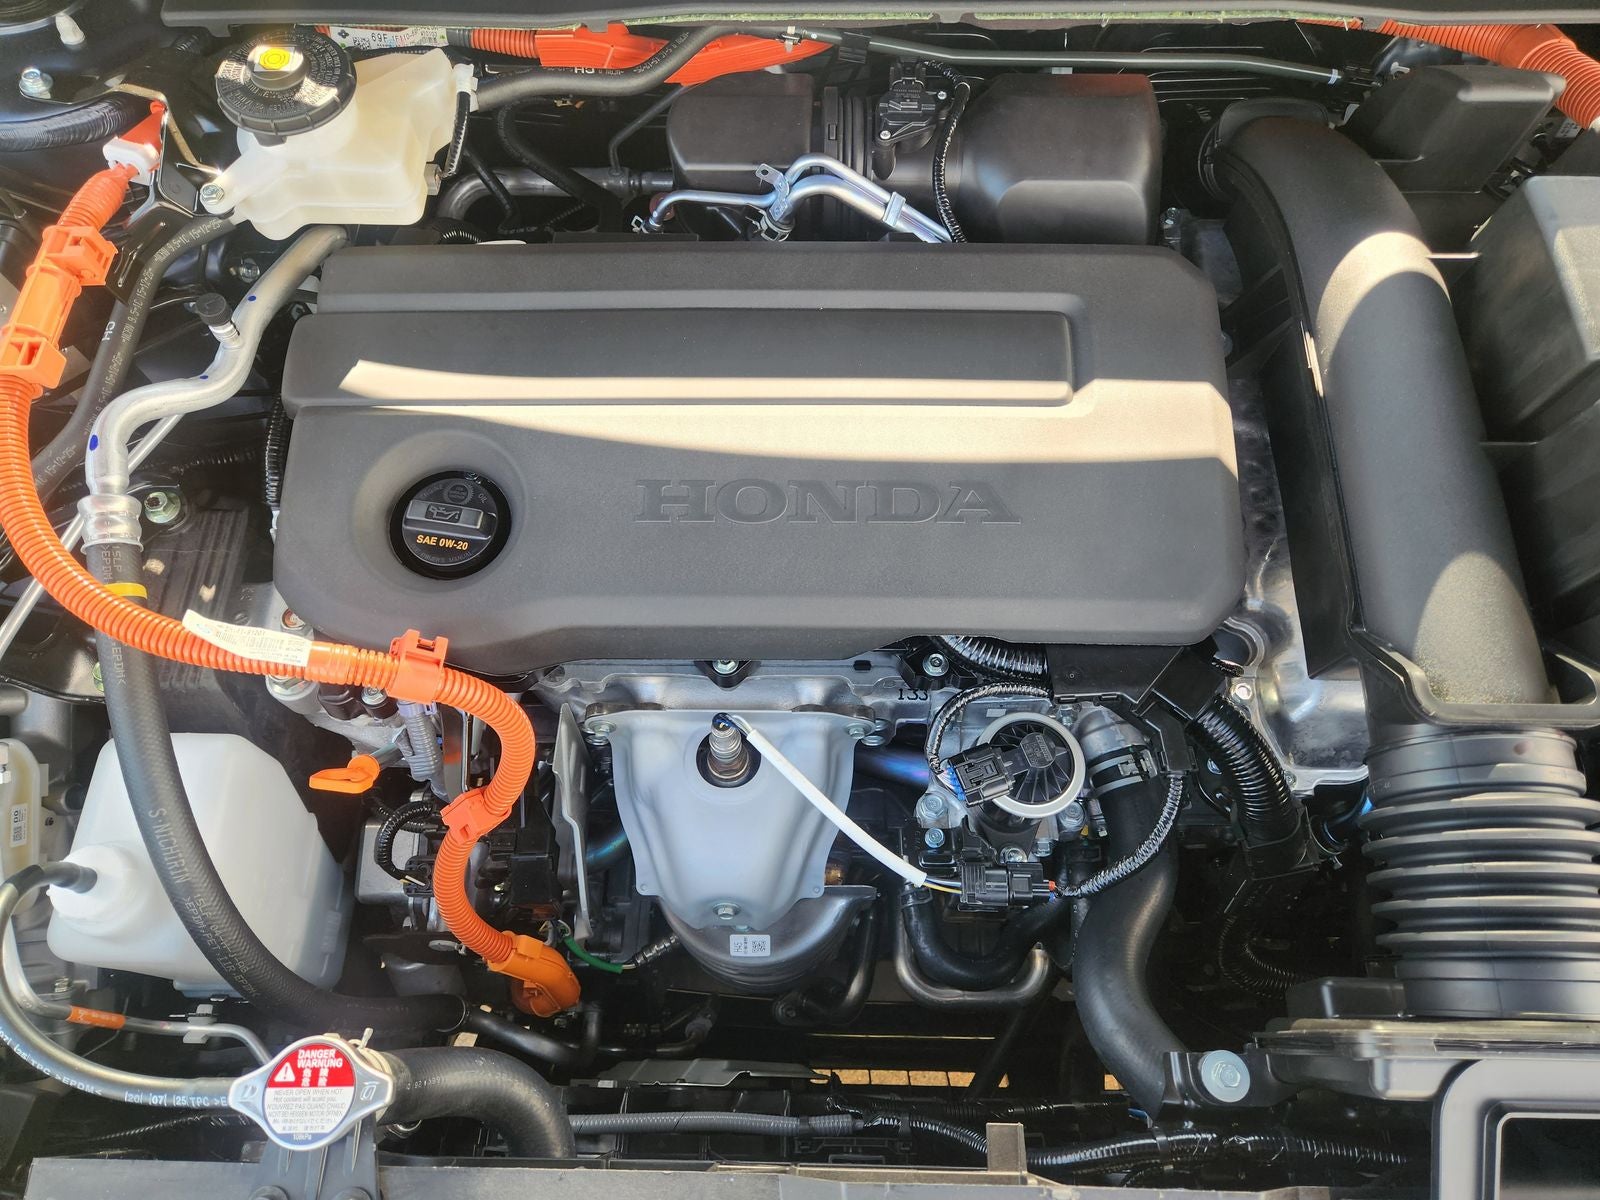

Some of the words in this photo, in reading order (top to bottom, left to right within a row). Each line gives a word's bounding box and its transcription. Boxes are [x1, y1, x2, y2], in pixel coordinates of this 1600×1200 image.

[635, 478, 1021, 525] HONDA
[416, 534, 438, 546] SAE
[439, 537, 469, 551] 0W-20
[298, 1048, 337, 1059] DANGER
[297, 1058, 343, 1069] WARNUNG
[189, 1095, 210, 1108] TPC
